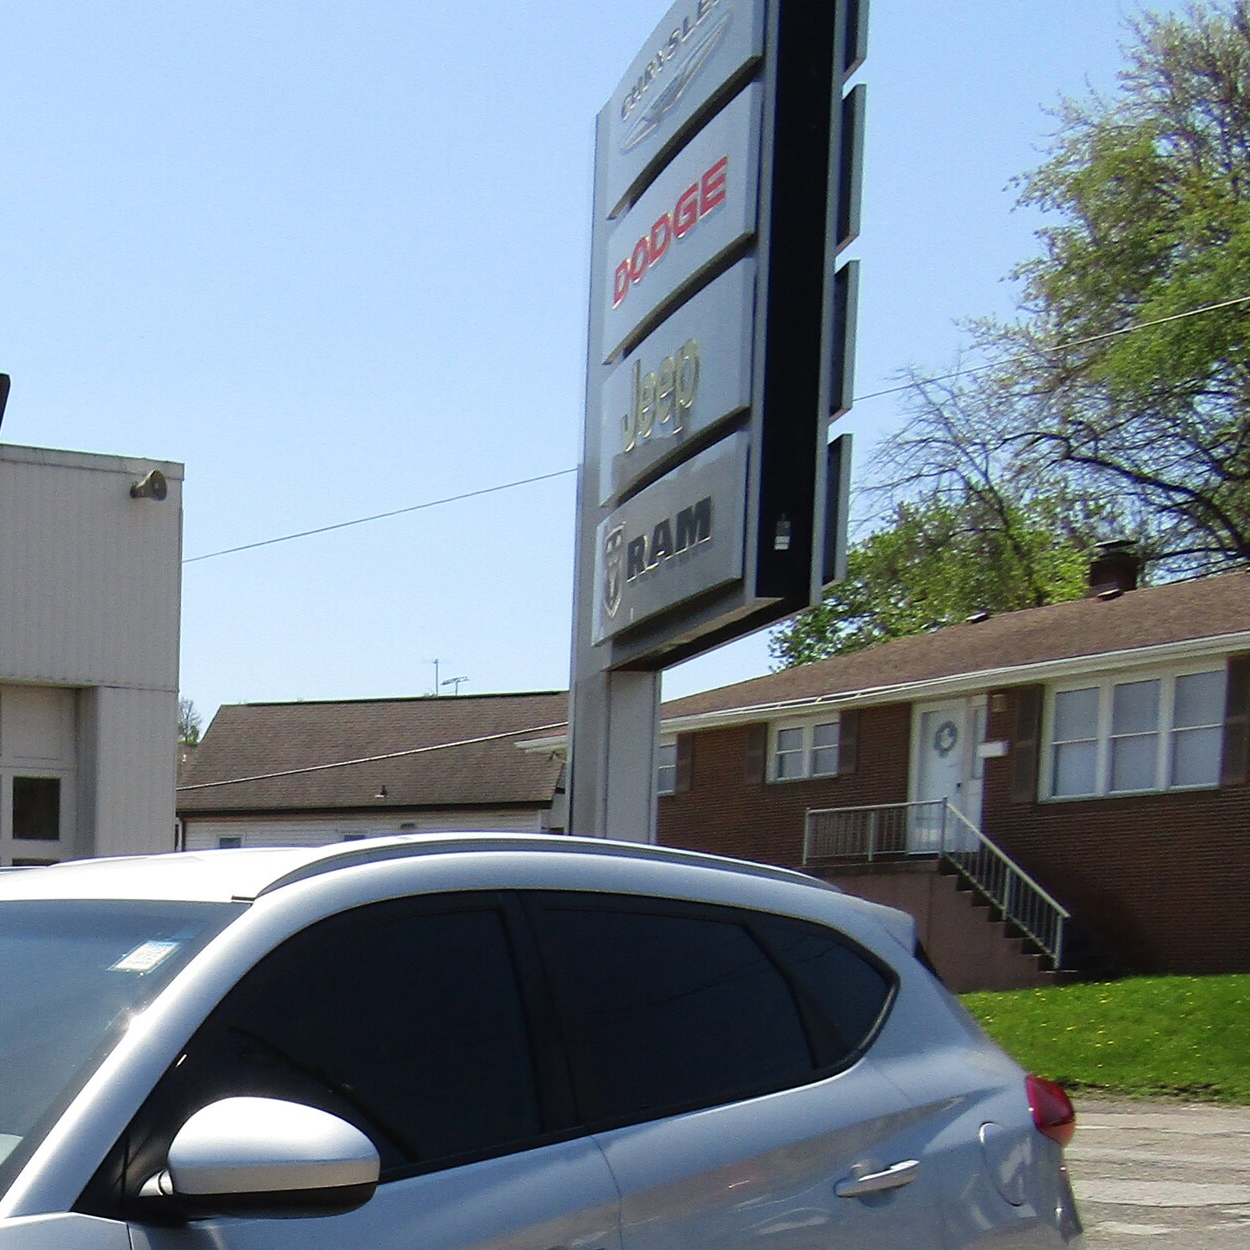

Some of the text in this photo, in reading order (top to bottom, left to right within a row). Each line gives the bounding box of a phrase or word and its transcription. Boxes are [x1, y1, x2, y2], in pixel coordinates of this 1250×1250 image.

[620, 0, 720, 122] CHRYSLE
[612, 154, 728, 309] DODGE
[621, 338, 700, 452] Jeep
[626, 496, 713, 583] RAM
